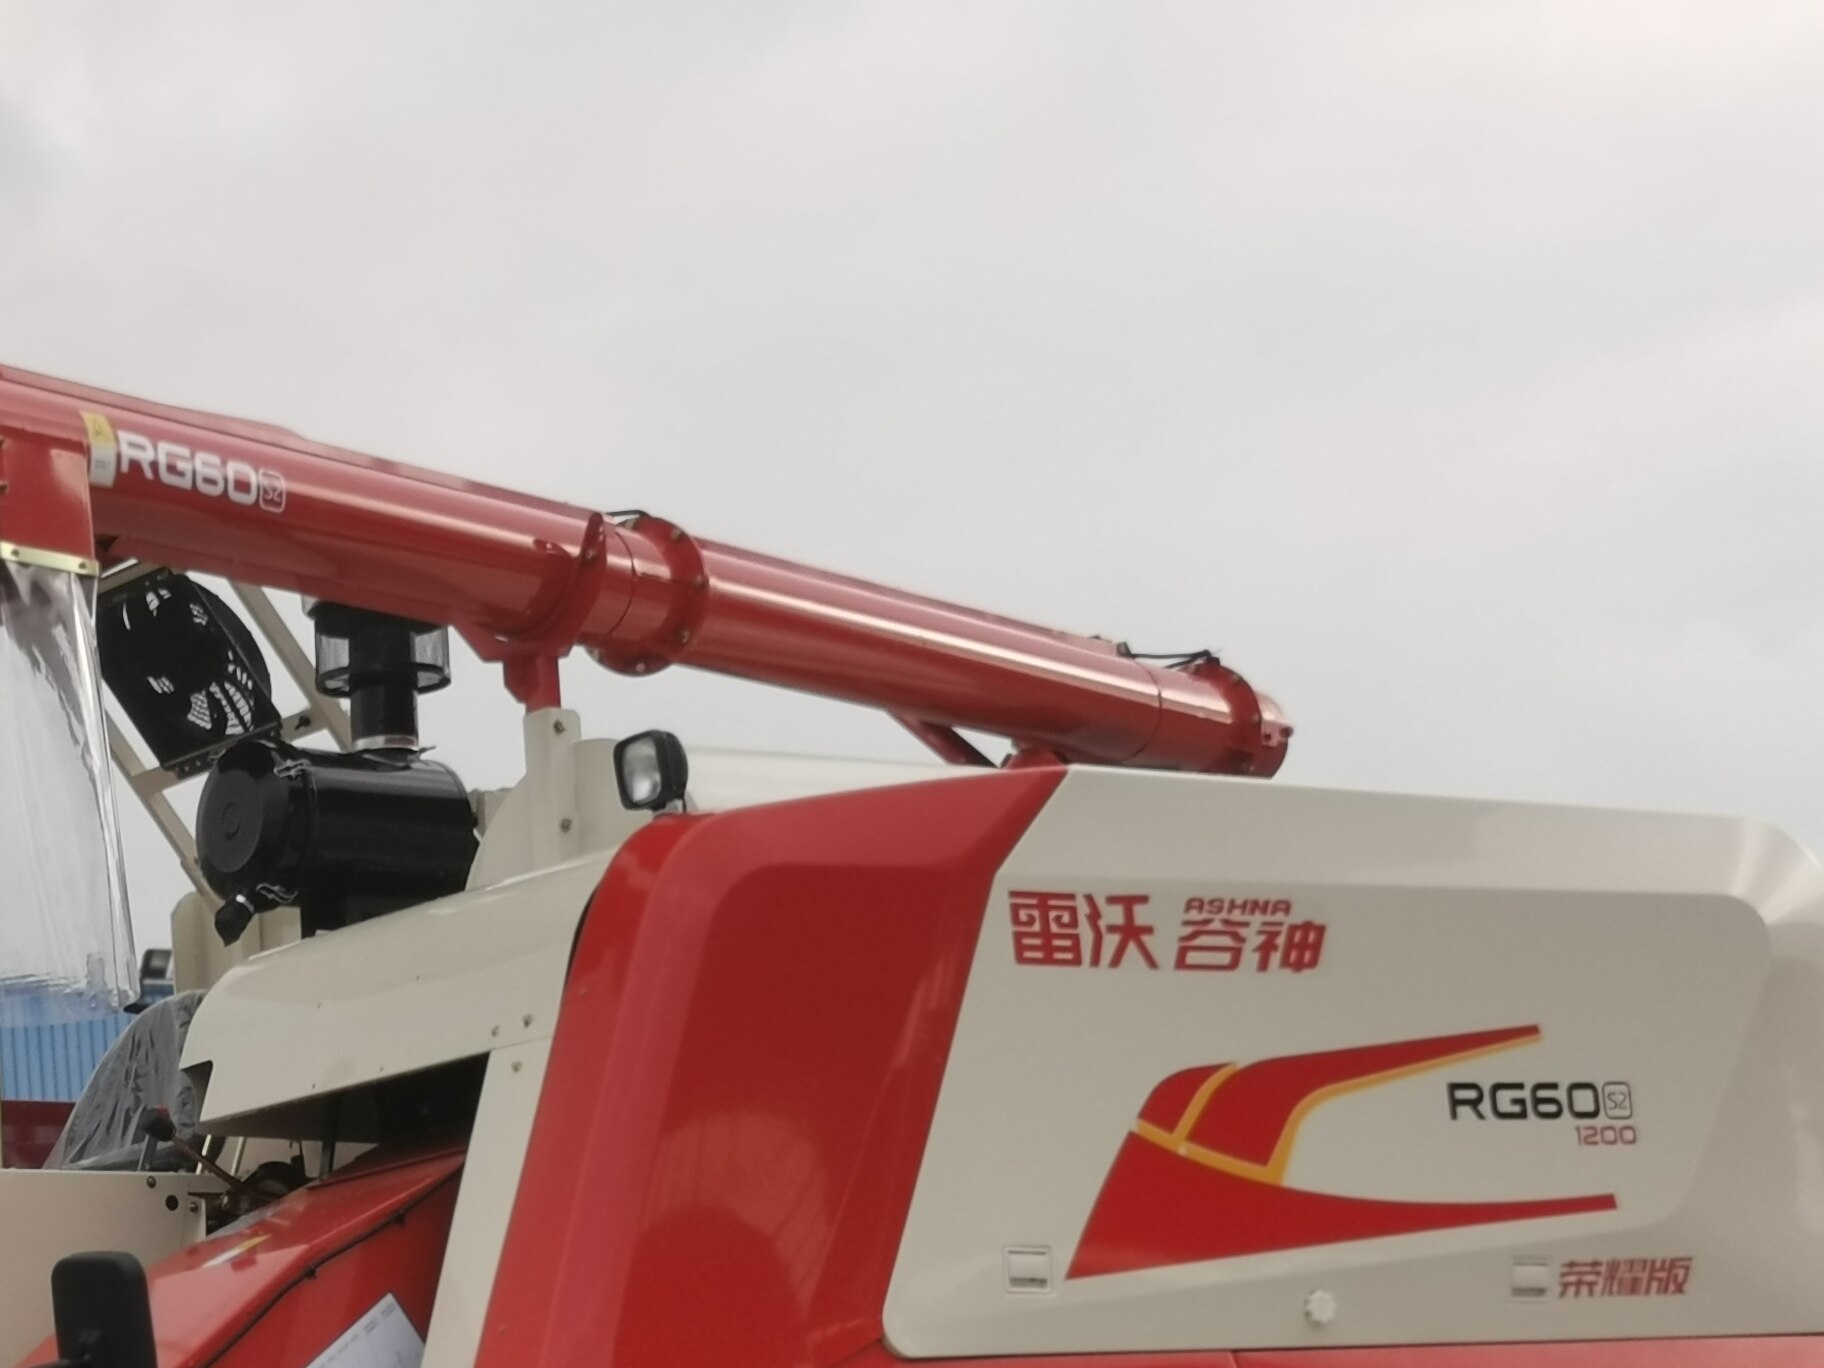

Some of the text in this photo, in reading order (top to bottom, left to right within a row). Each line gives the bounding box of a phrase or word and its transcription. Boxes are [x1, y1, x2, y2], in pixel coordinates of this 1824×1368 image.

[117, 429, 257, 506] RG60
[1184, 896, 1292, 916] ASHNA
[1008, 890, 1327, 974] 雷沃 谷神
[1446, 1081, 1600, 1121] RG60
[1576, 1125, 1637, 1146] 1200
[1559, 1257, 1693, 1298] 荣耀版
